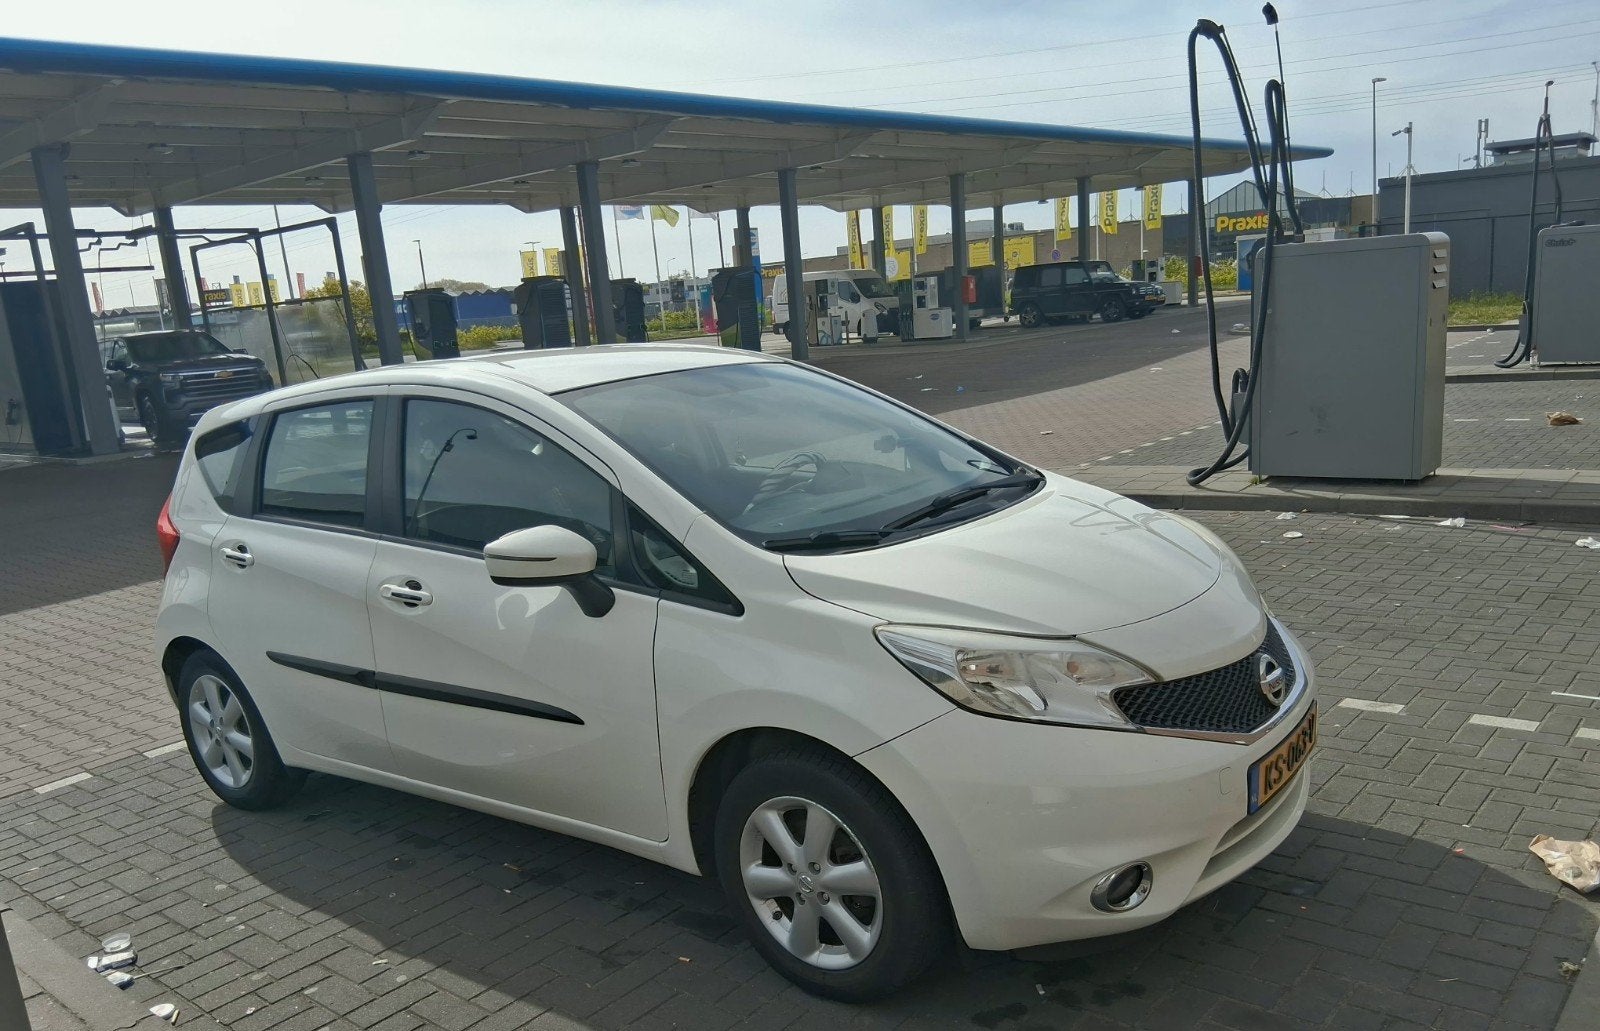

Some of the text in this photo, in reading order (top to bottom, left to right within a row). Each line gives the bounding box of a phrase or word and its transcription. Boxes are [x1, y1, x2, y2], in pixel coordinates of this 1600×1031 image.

[1104, 191, 1114, 226] Praxi
[1148, 185, 1158, 222] Praxi
[1216, 214, 1269, 232] Praxis
[203, 291, 227, 301] raxis
